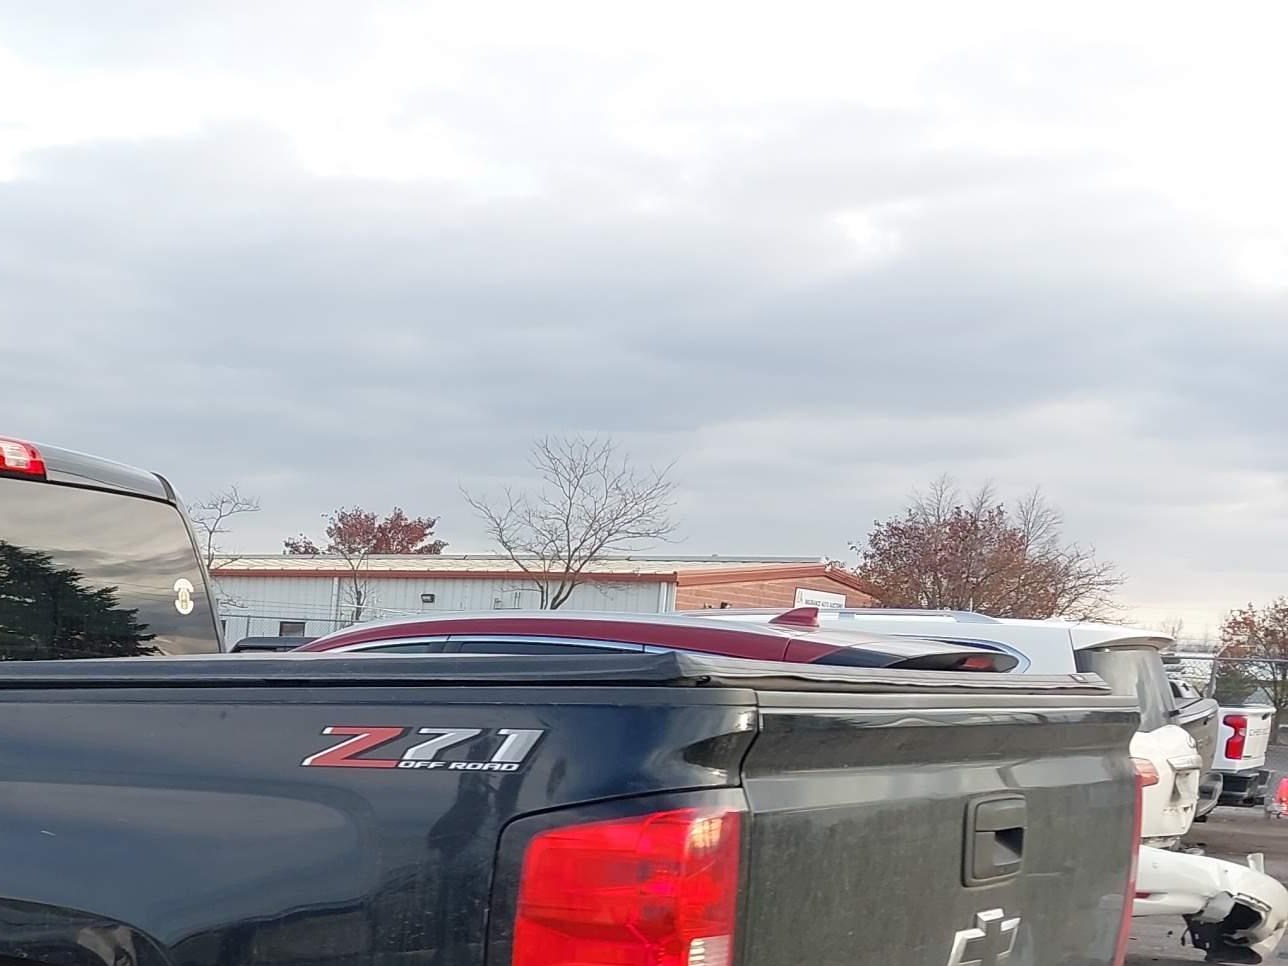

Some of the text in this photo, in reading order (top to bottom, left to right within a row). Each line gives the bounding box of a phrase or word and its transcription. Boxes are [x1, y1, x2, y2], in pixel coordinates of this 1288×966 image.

[301, 727, 545, 769] Z71
[398, 761, 521, 772] OFF ROAD
